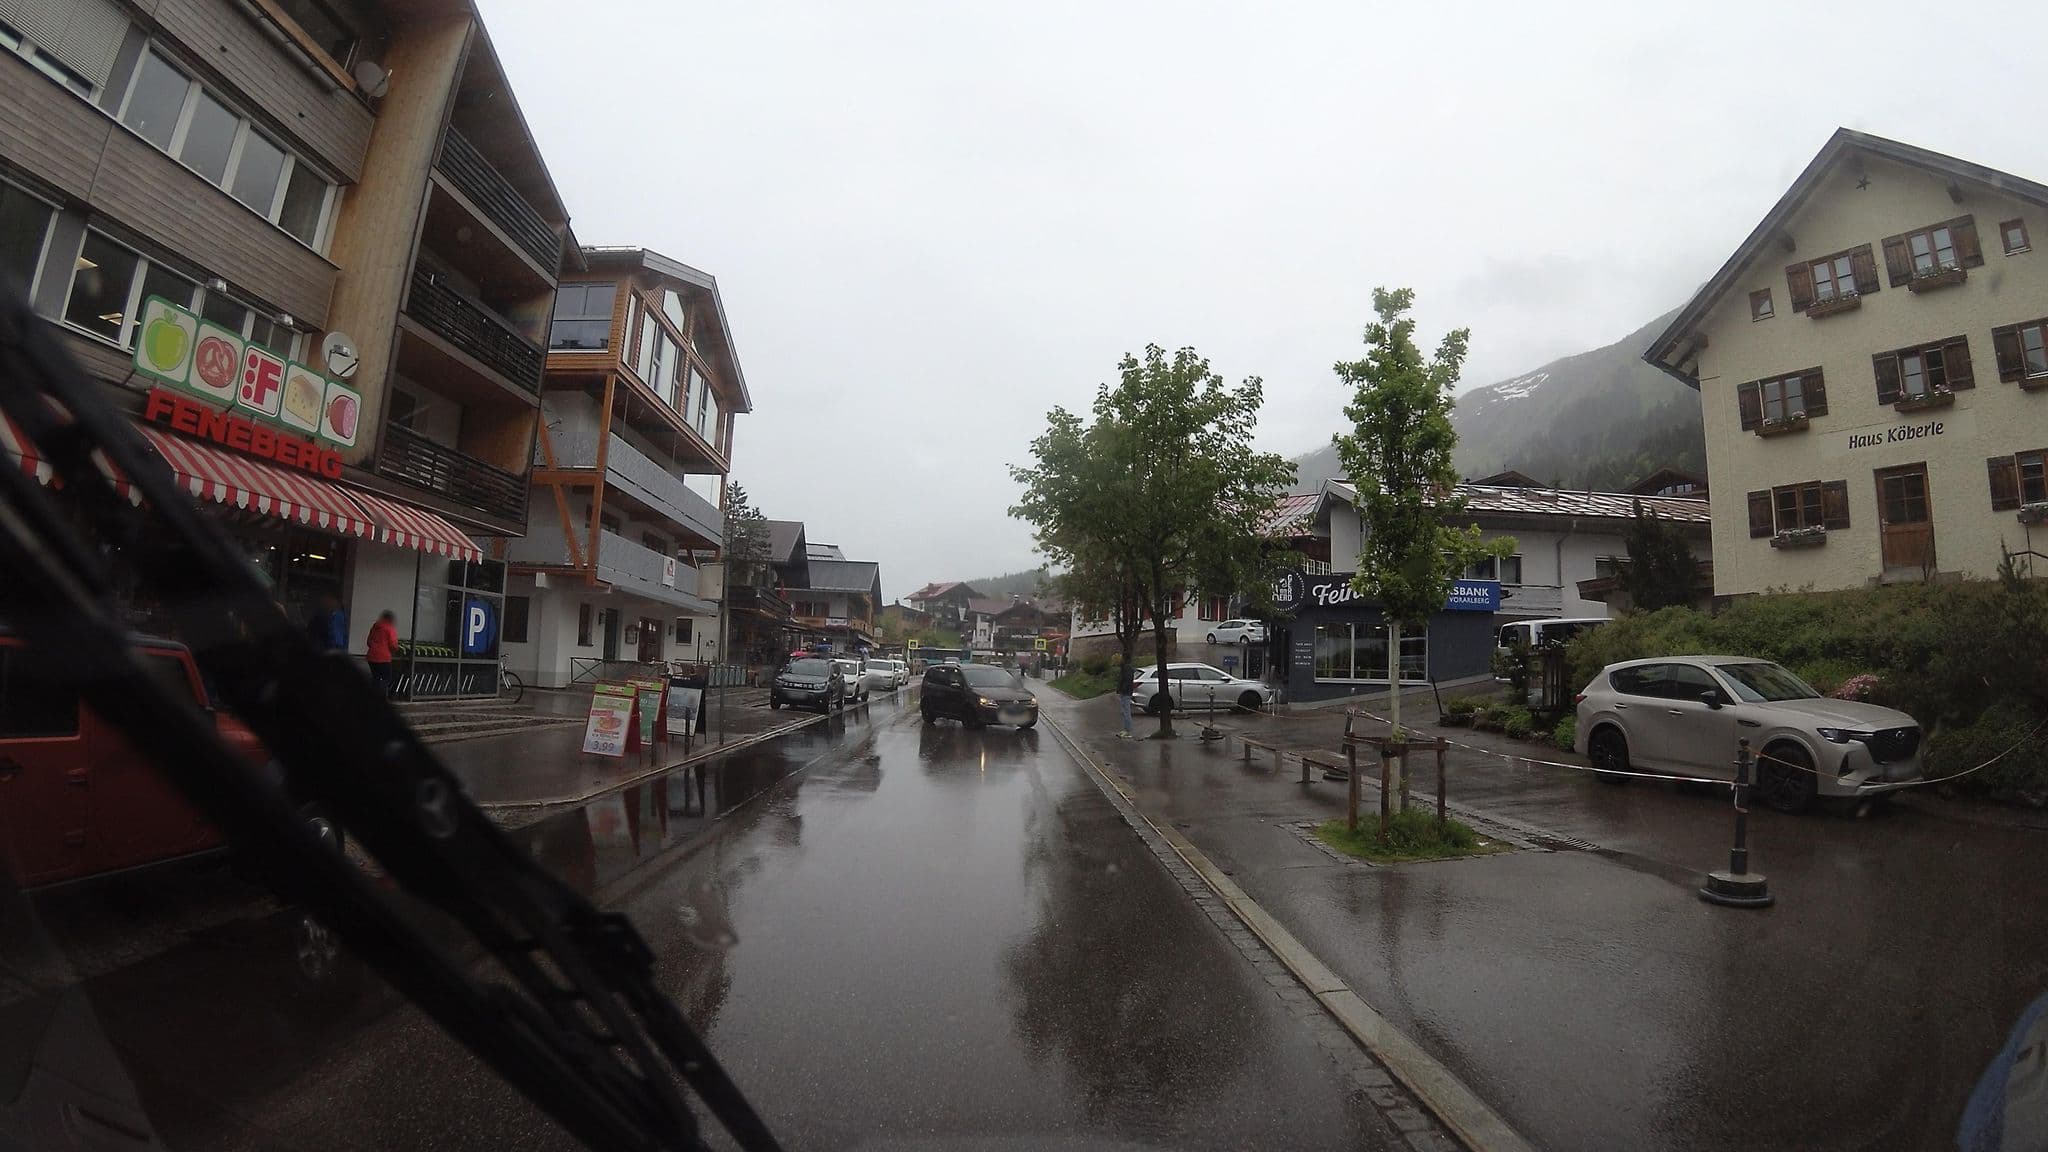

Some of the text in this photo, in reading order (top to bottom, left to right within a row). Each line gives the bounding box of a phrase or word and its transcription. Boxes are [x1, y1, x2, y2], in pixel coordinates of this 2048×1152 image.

[254, 358, 282, 405] F
[145, 388, 344, 479] FENEBERG
[1848, 422, 1944, 449] Haus Köberle
[1446, 586, 1489, 597] SBANK
[468, 607, 486, 646] P
